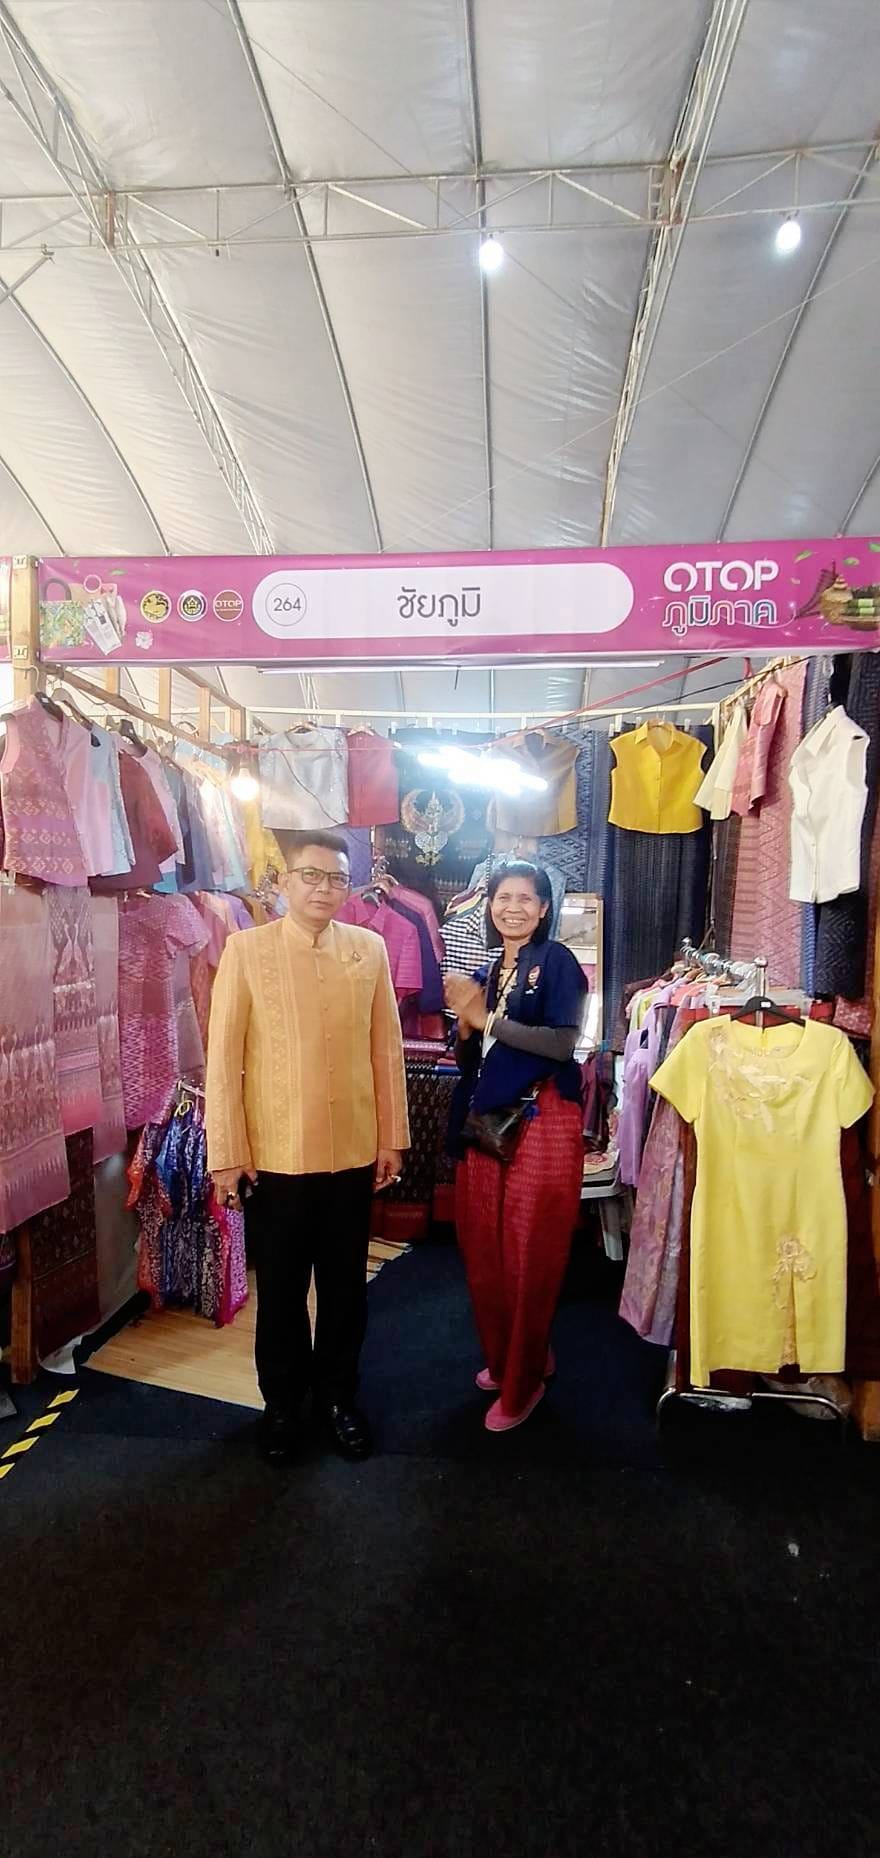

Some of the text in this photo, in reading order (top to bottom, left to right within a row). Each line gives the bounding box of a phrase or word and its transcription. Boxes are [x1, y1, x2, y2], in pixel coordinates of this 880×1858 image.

[663, 560, 779, 592] OTOP
[215, 600, 242, 608] OTOP
[273, 598, 302, 612] 264
[397, 586, 481, 627] ชัยภูมิ
[662, 595, 777, 636] ภูมิภาค
